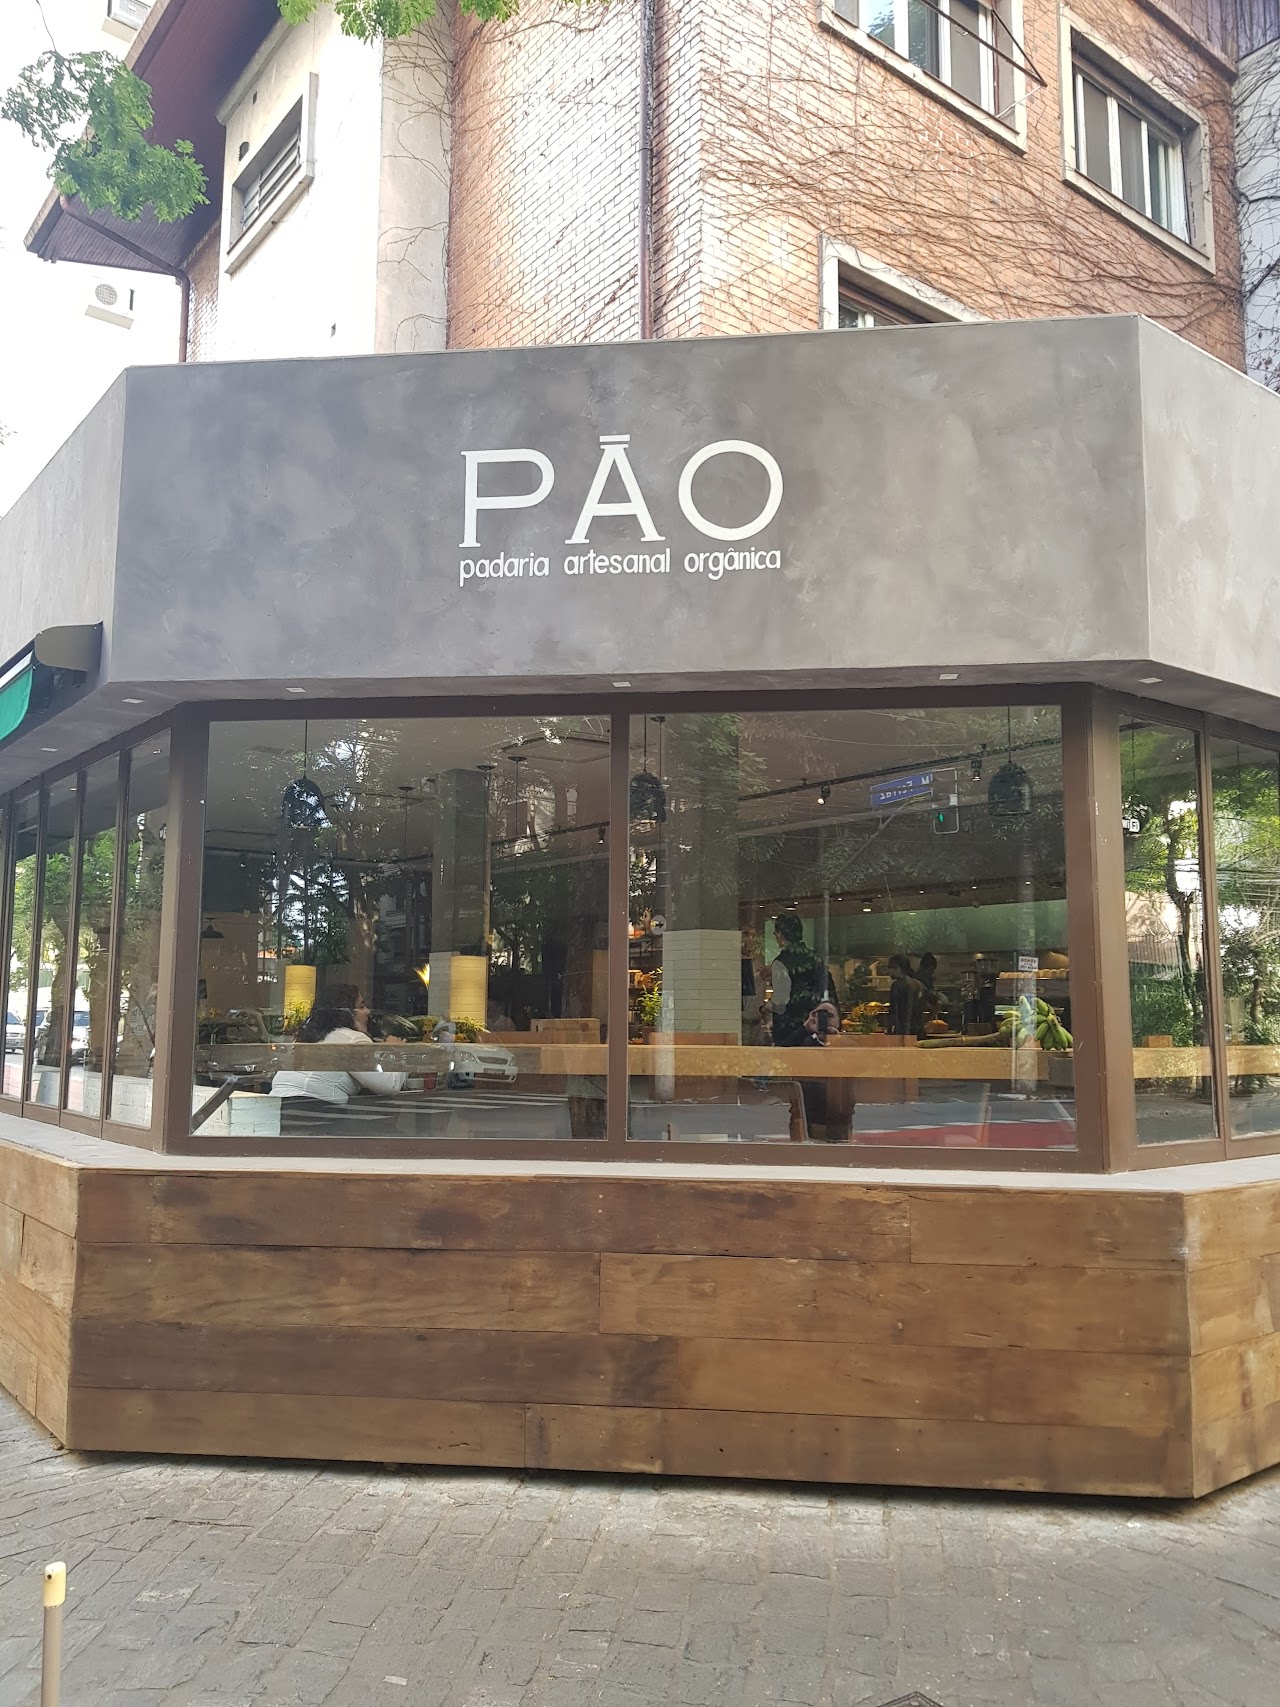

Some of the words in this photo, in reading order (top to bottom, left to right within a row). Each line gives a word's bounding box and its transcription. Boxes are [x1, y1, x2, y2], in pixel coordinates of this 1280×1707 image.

[459, 552, 550, 587] padaria
[563, 548, 671, 575] artesanal
[684, 547, 781, 580] orgânica
